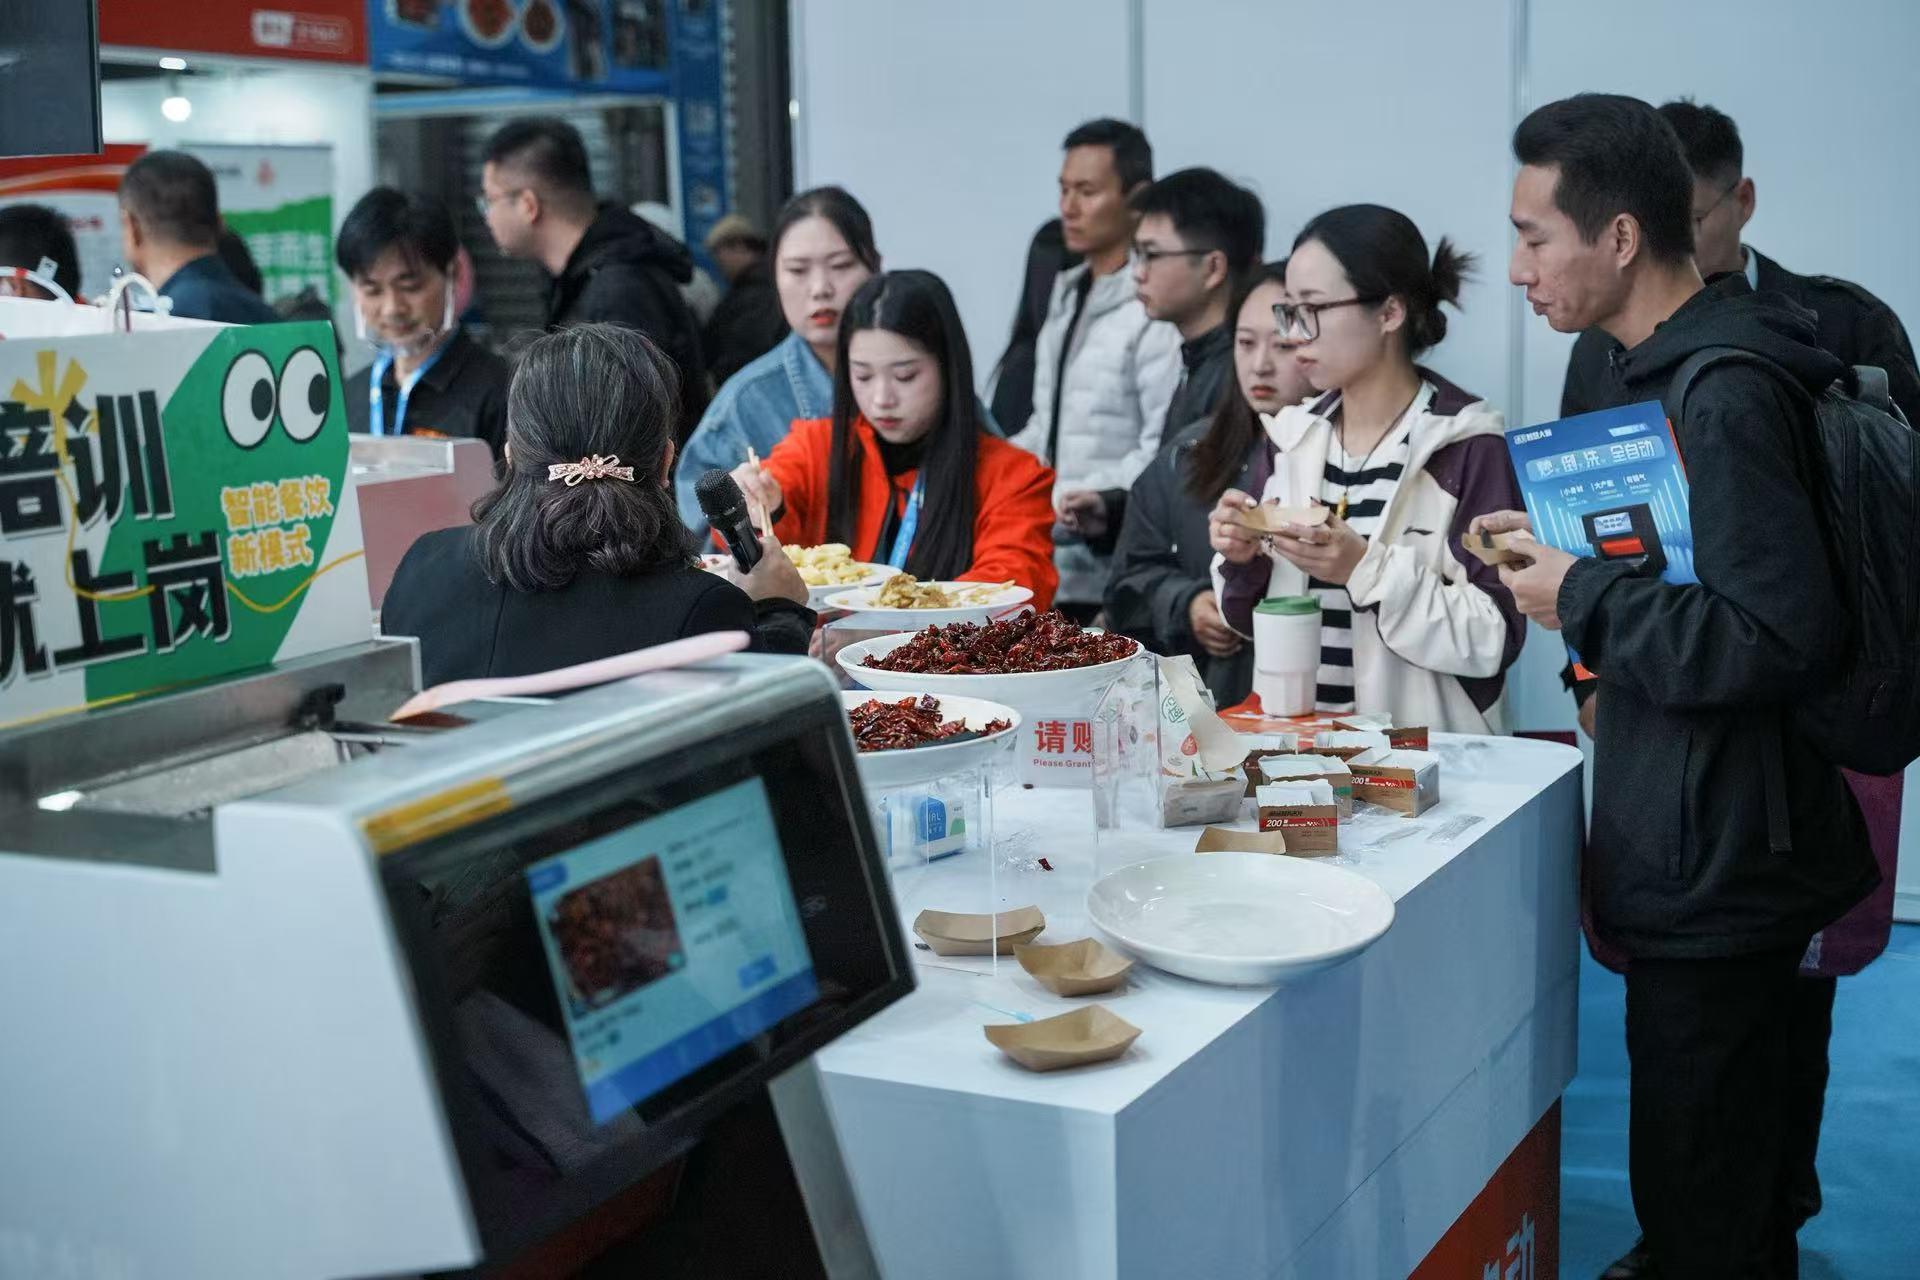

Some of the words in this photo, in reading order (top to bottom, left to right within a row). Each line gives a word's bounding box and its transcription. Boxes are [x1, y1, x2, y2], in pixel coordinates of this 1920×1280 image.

[221, 475, 334, 532] 智能餐饮
[228, 523, 314, 579] 新模式
[1033, 759, 1063, 768] Please
[1265, 819, 1282, 828] 200
